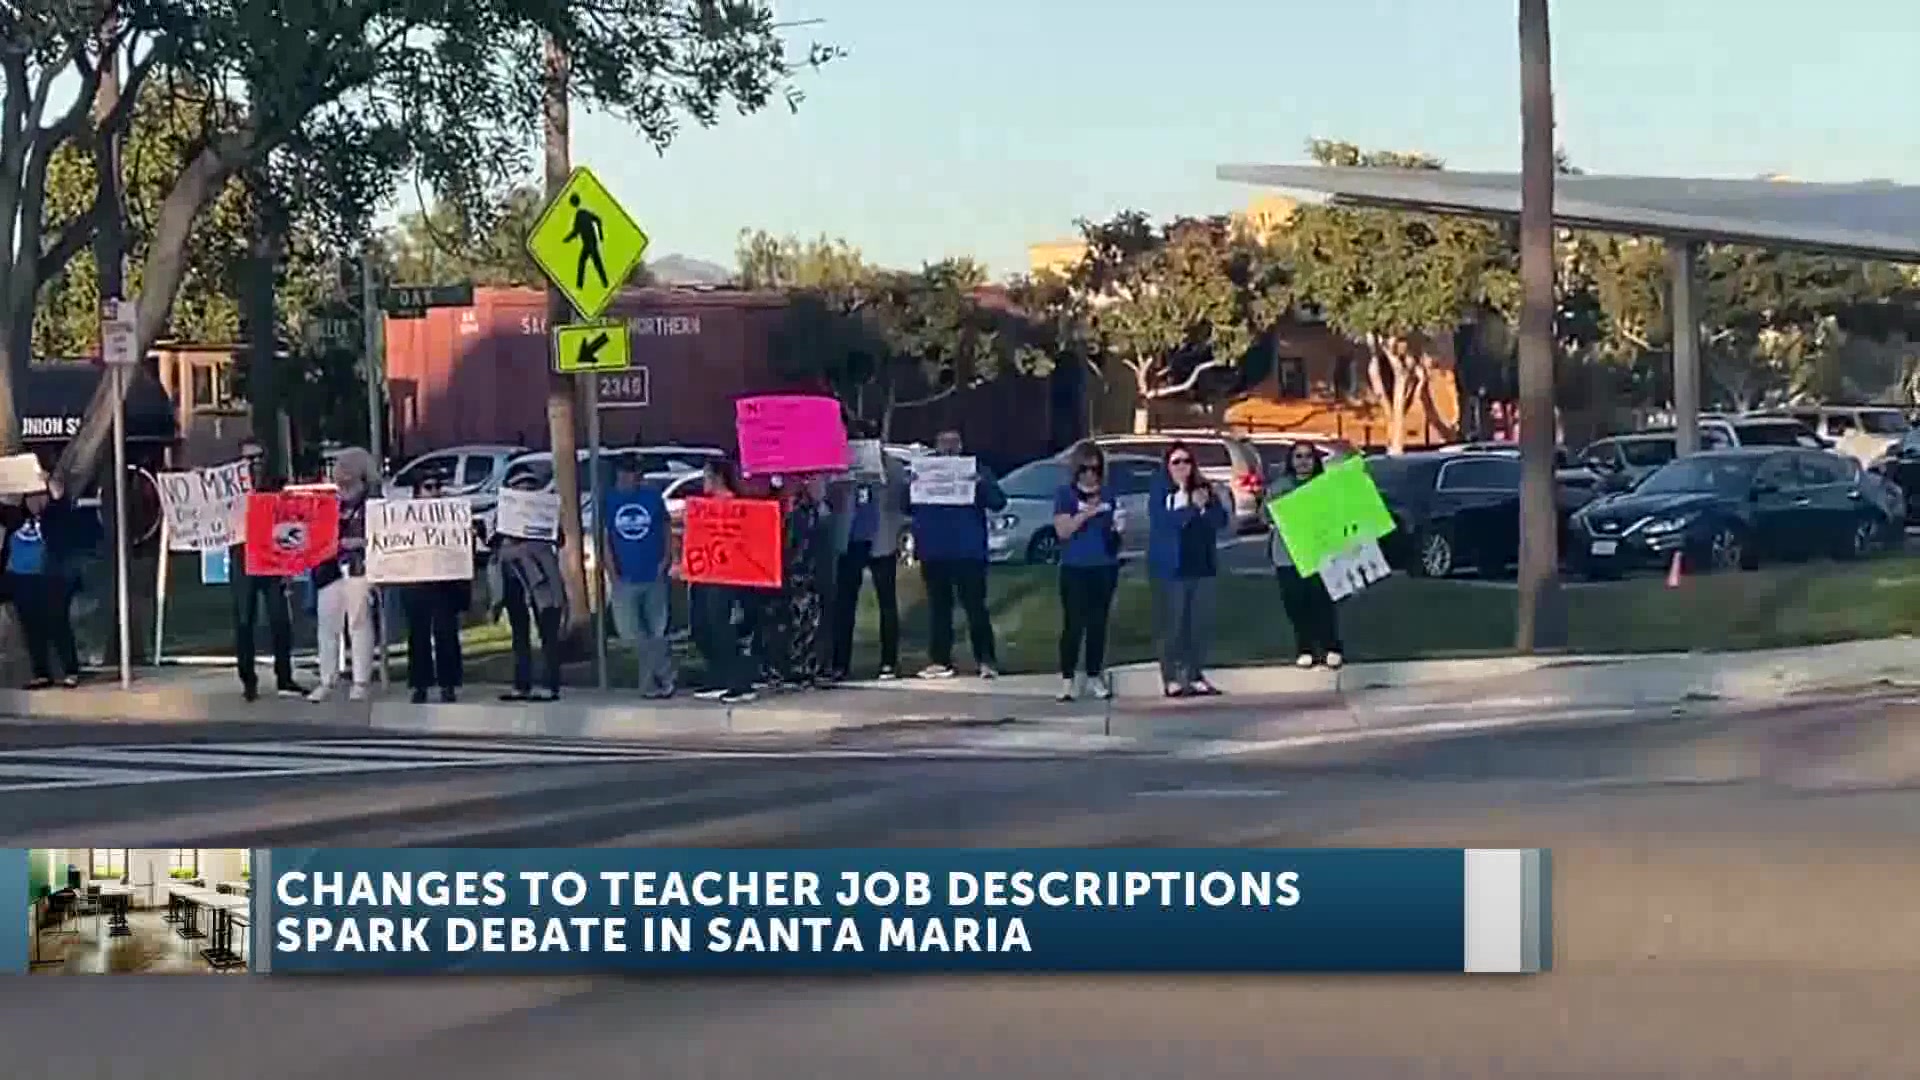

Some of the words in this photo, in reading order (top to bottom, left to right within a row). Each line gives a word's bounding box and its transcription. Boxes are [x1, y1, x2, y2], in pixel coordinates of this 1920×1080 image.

[399, 289, 433, 307] OAK
[160, 476, 190, 505] NO
[197, 462, 249, 504] MORE
[381, 501, 471, 527] TEACHERS
[686, 541, 728, 576] BIG
